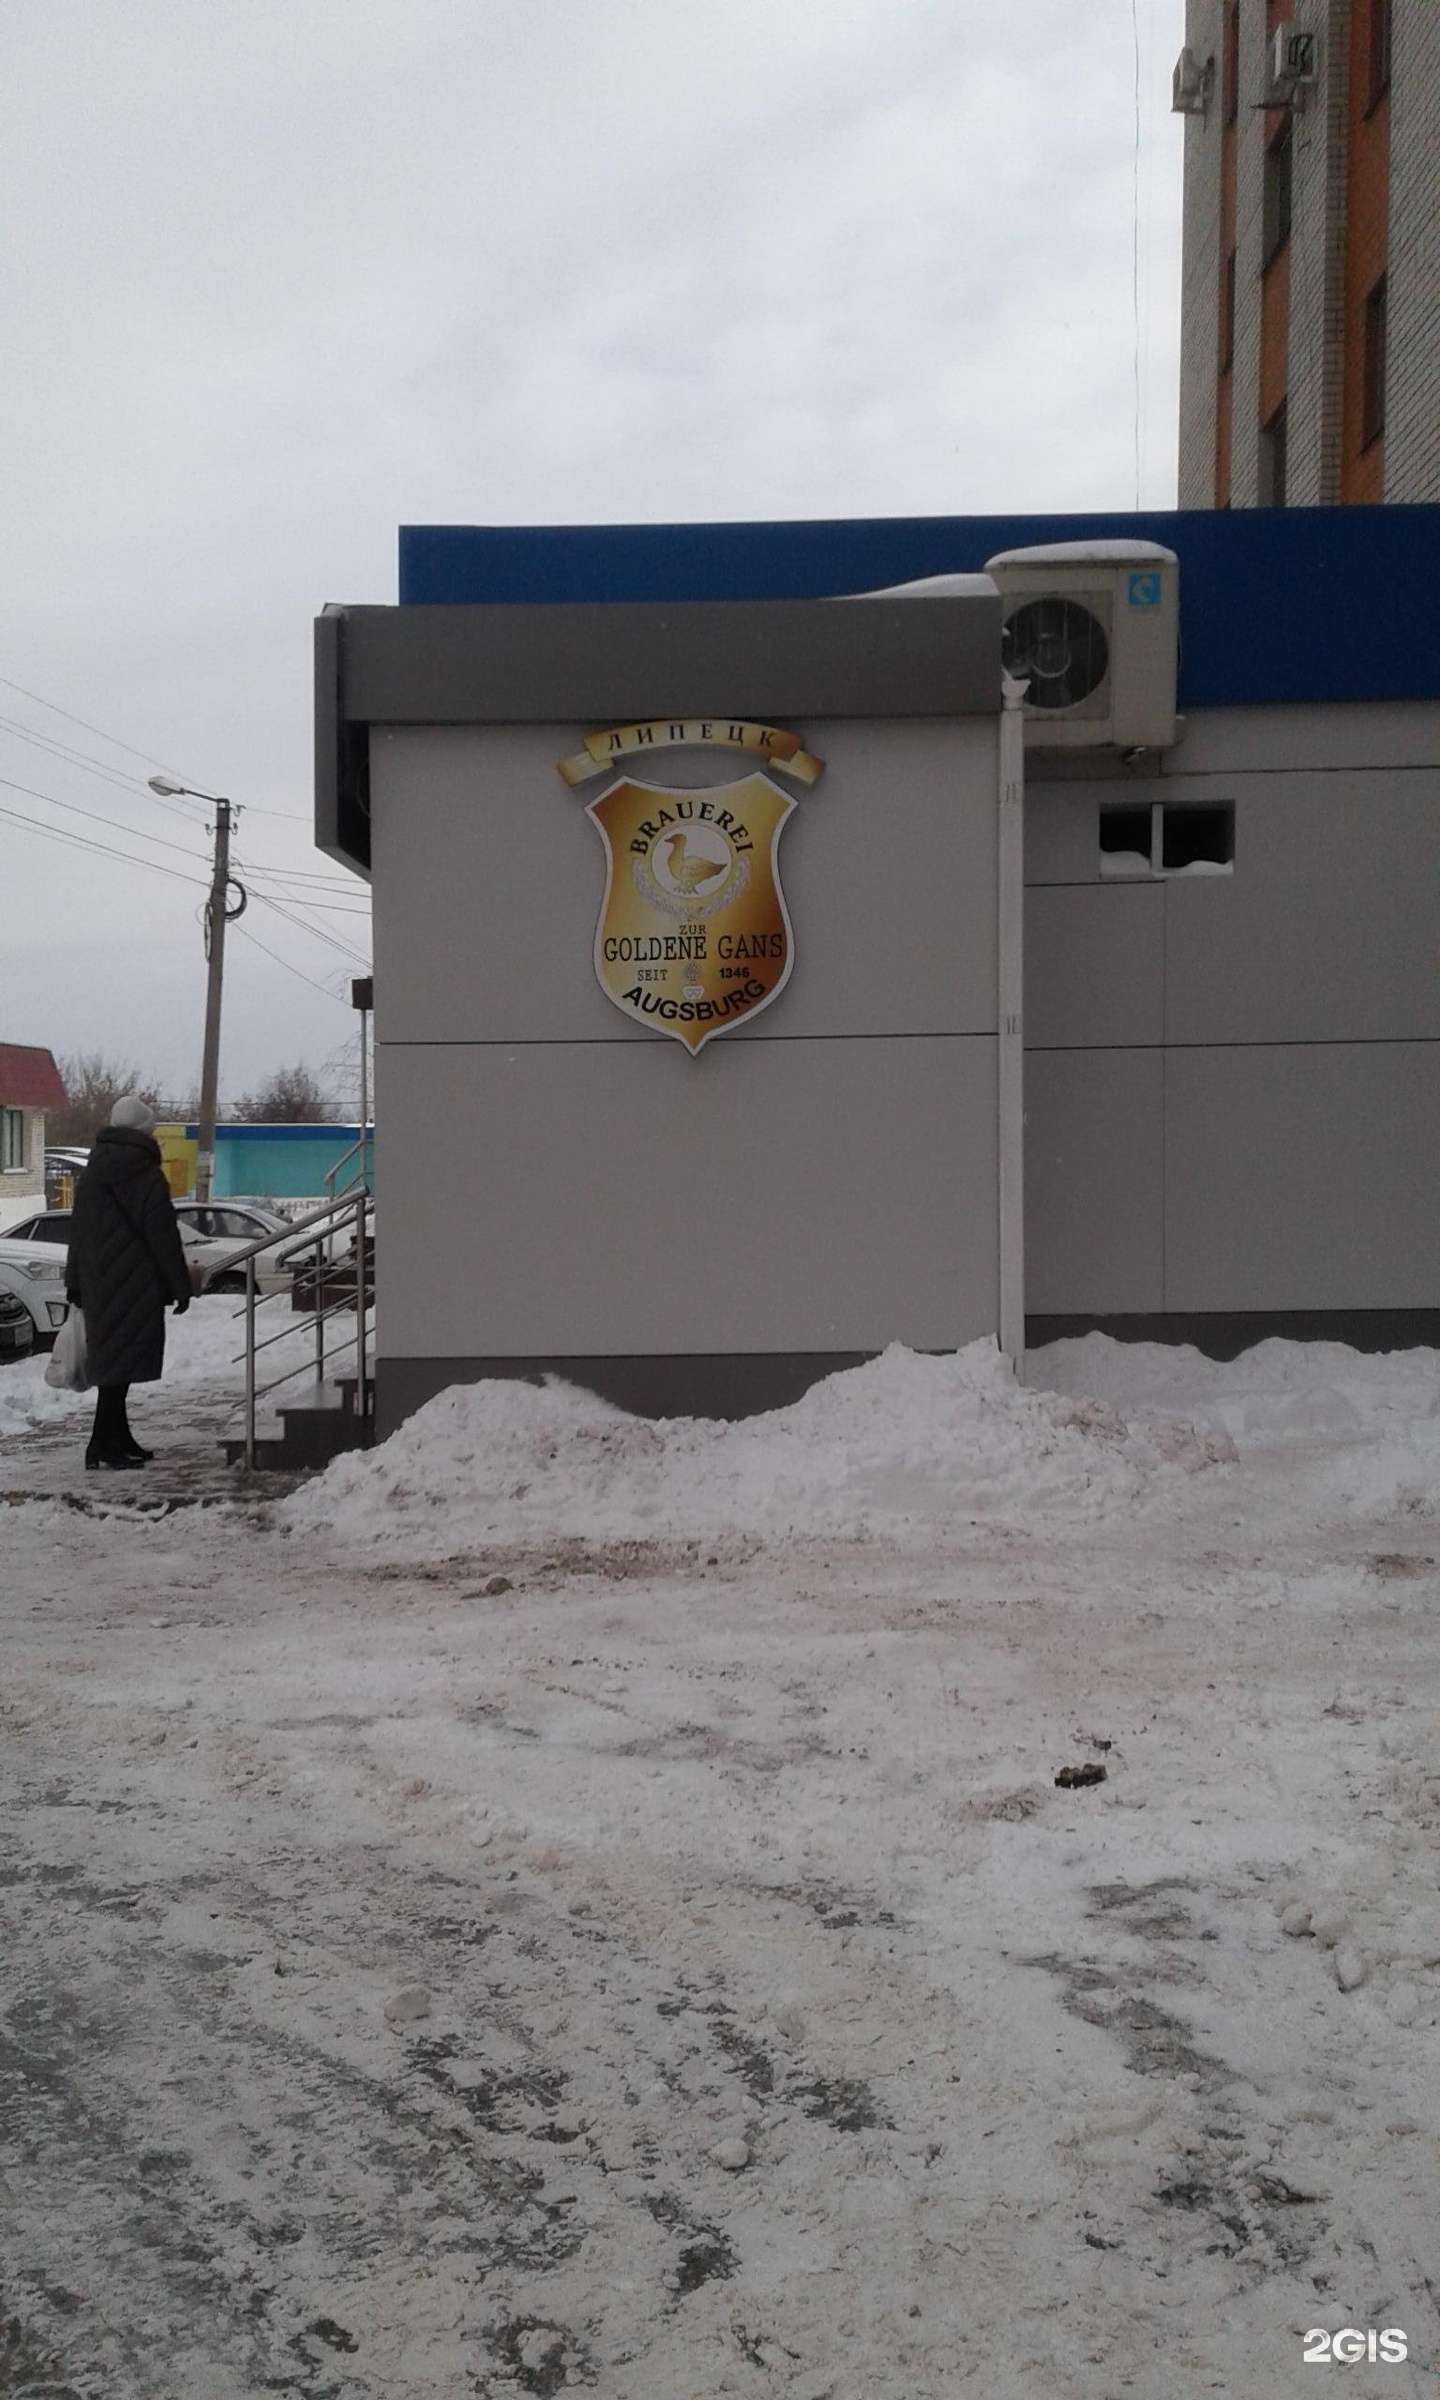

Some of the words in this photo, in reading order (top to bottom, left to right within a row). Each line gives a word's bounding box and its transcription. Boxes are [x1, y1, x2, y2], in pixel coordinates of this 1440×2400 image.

[608, 723, 778, 751] ЛИПЕЦК
[630, 801, 753, 856] BRAUEREI
[679, 924, 707, 935] ZUR
[604, 936, 707, 962] GOLDENE
[718, 933, 783, 959] GANS
[637, 969, 668, 982] SEIT
[622, 978, 765, 1021] AUGSBURG
